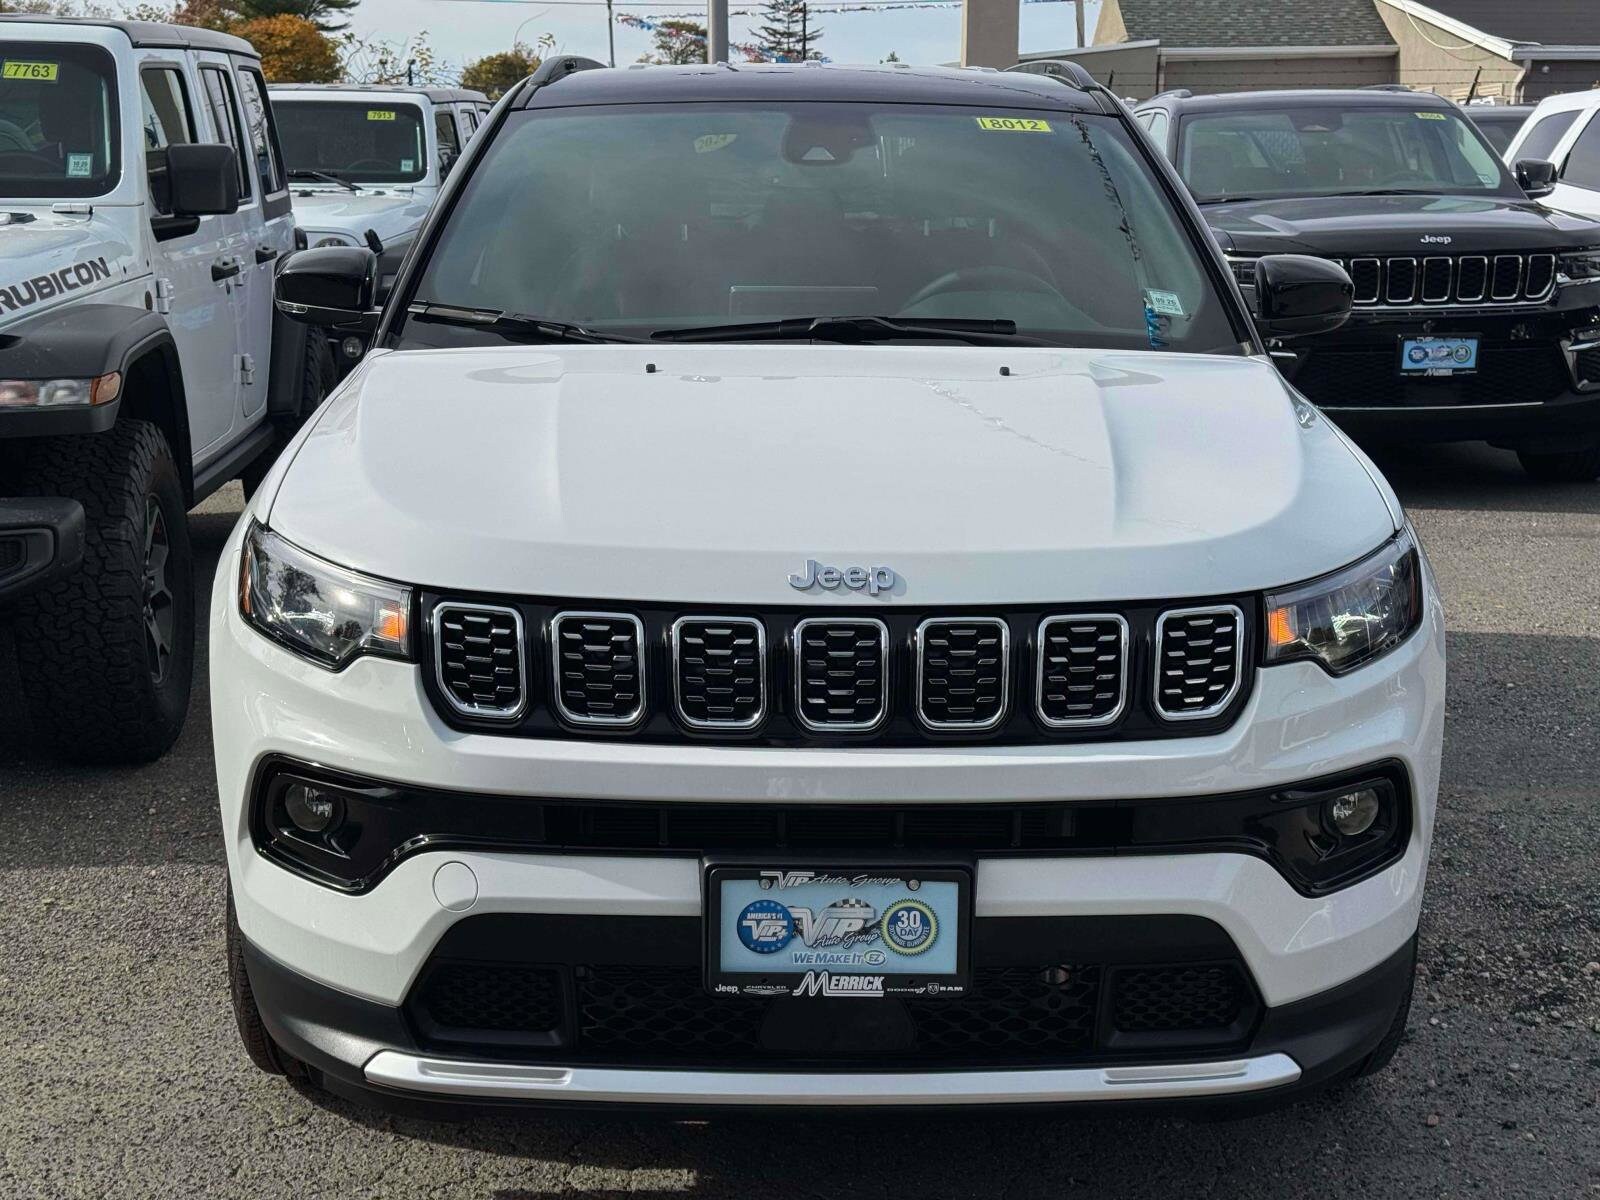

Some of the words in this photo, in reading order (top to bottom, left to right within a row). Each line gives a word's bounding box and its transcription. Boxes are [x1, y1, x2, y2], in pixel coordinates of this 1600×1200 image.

[1420, 234, 1452, 245] Jeep
[0, 256, 111, 315] RUBICON
[787, 559, 895, 596] Jeep
[760, 870, 815, 890] VIP
[808, 874, 848, 886] Auto
[850, 874, 901, 888] Group
[788, 907, 875, 948] VIP
[897, 910, 921, 928] 30
[813, 935, 841, 949] Auto
[843, 930, 880, 949] Group
[900, 928, 919, 937] DAY
[793, 952, 815, 964] WE
[815, 952, 851, 964] MAKE
[851, 952, 864, 964] IT
[715, 984, 739, 994] Jeep
[792, 970, 885, 998] MERRICK
